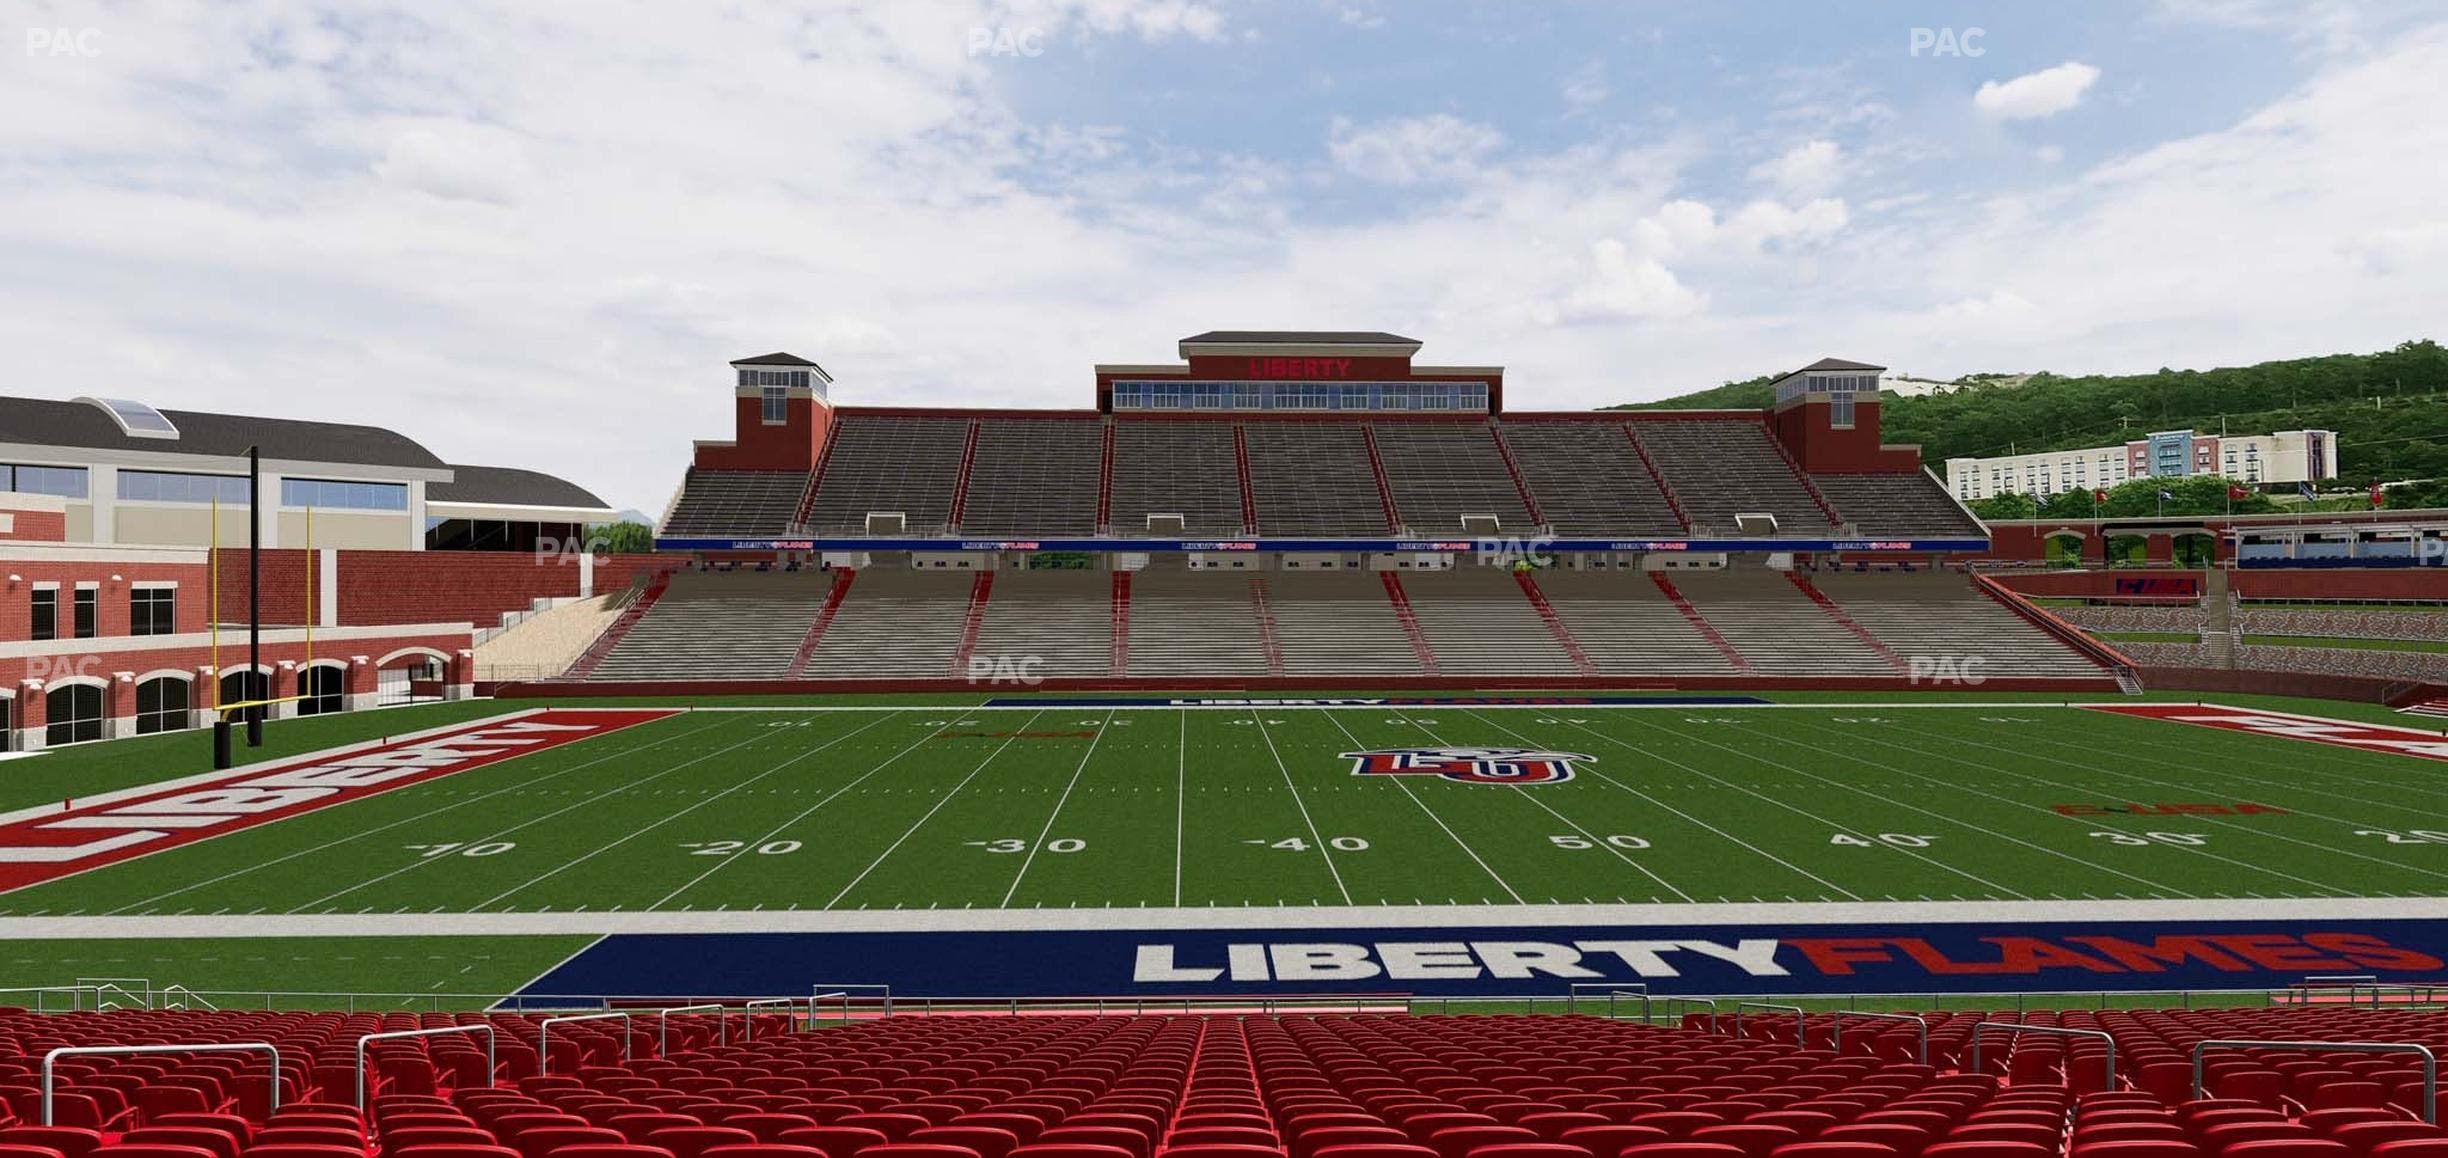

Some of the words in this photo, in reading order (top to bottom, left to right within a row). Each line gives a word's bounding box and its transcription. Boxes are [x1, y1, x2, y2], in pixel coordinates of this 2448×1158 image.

[1248, 358, 1352, 377] LIBERTY
[0, 721, 600, 863] LIBERTY
[985, 838, 1087, 854] 30
[1269, 836, 1370, 852] 40
[1548, 834, 1651, 850] 50
[1829, 832, 1930, 848] 40
[2088, 831, 2207, 846] 30
[419, 841, 516, 857] 10
[688, 840, 802, 855] 20
[1133, 939, 1789, 981] LIBERTY
[1781, 932, 2445, 975] FLAMES
